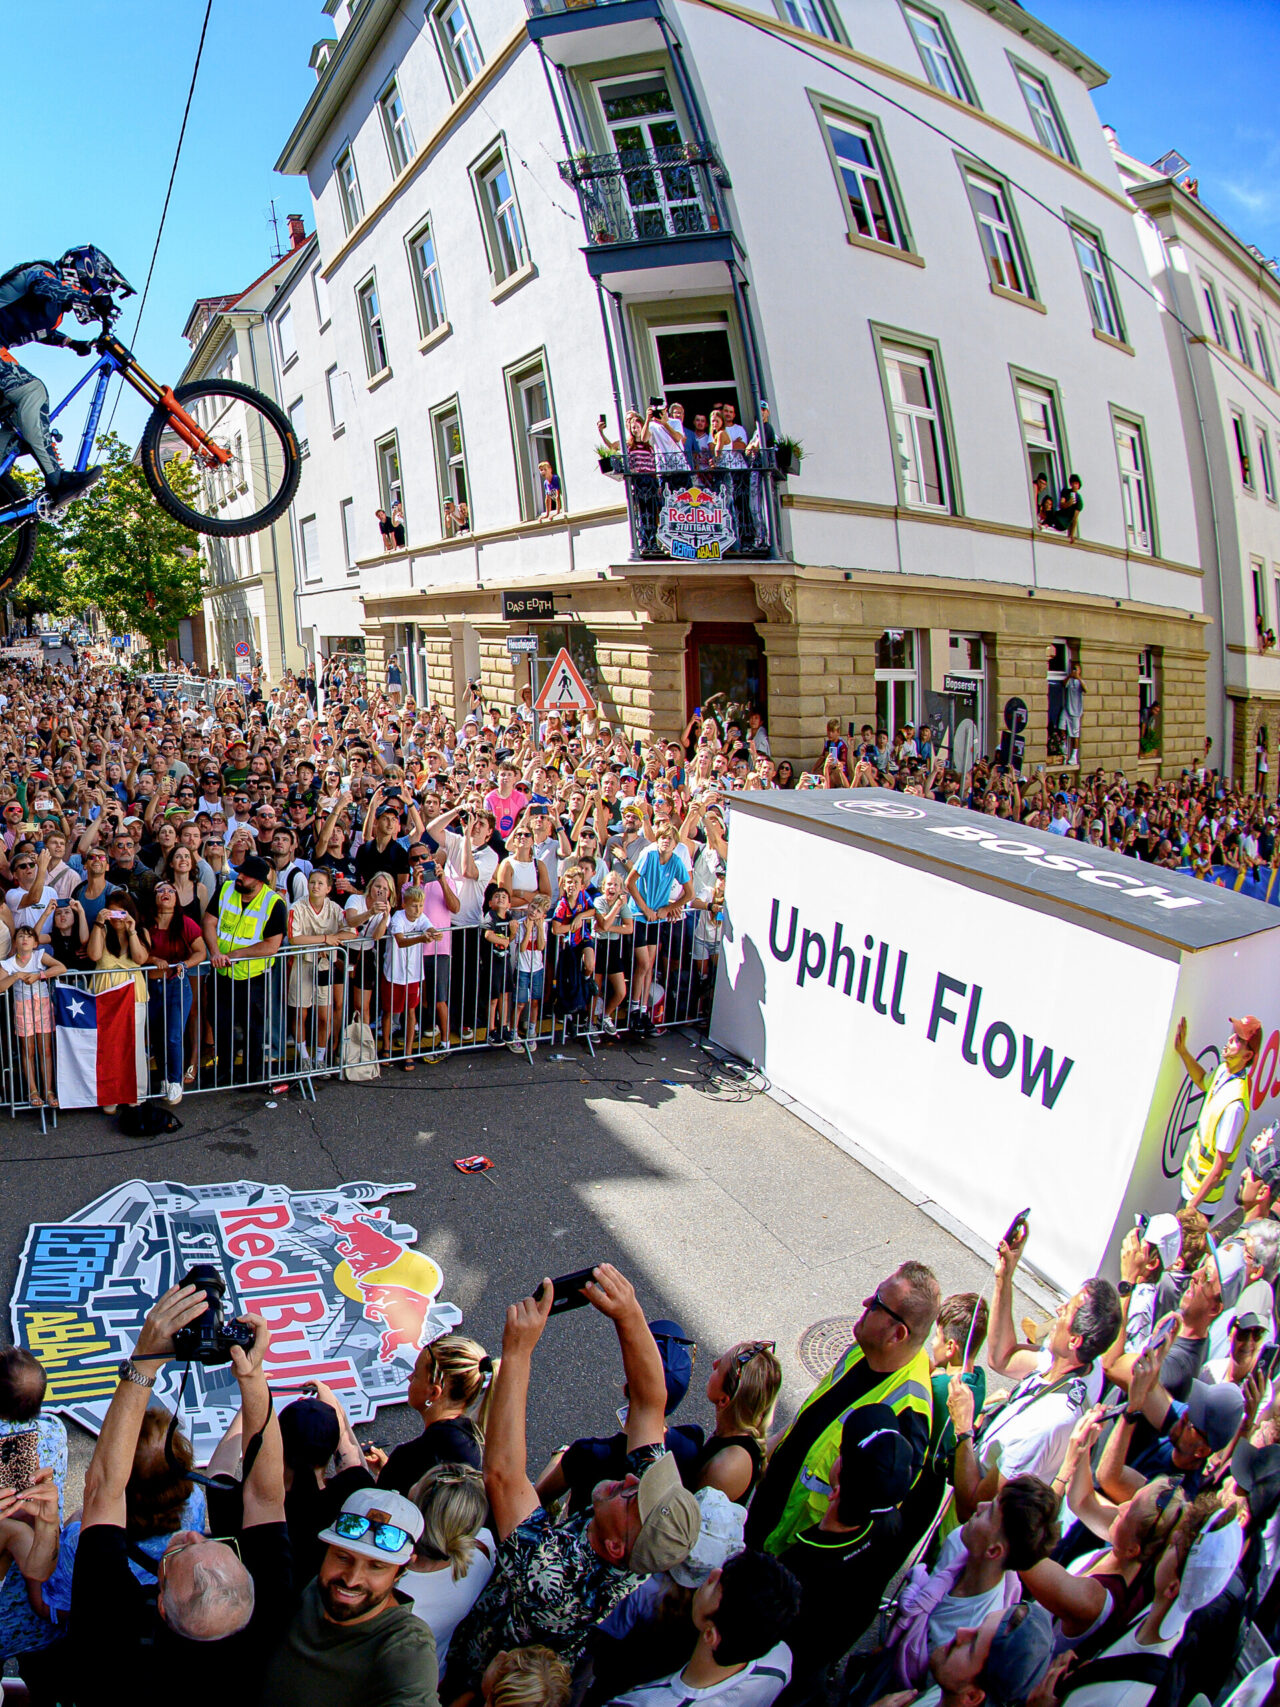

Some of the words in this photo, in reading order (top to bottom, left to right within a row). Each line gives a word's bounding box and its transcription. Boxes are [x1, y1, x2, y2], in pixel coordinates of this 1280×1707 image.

[85, 378, 109, 442] NORCO
[669, 508, 695, 522] Red
[696, 509, 722, 524] Bull
[675, 523, 716, 532] STUTTGART
[697, 542, 720, 559] ABAJO
[506, 601, 524, 613] DAS
[526, 598, 552, 613] EDITH
[945, 677, 977, 691] Bopserstr.
[926, 826, 1204, 909] BOSCH
[768, 897, 909, 1026] Uphill
[926, 971, 1075, 1110] Flow
[25, 1228, 117, 1302] CERRO
[220, 1204, 321, 1290] Red
